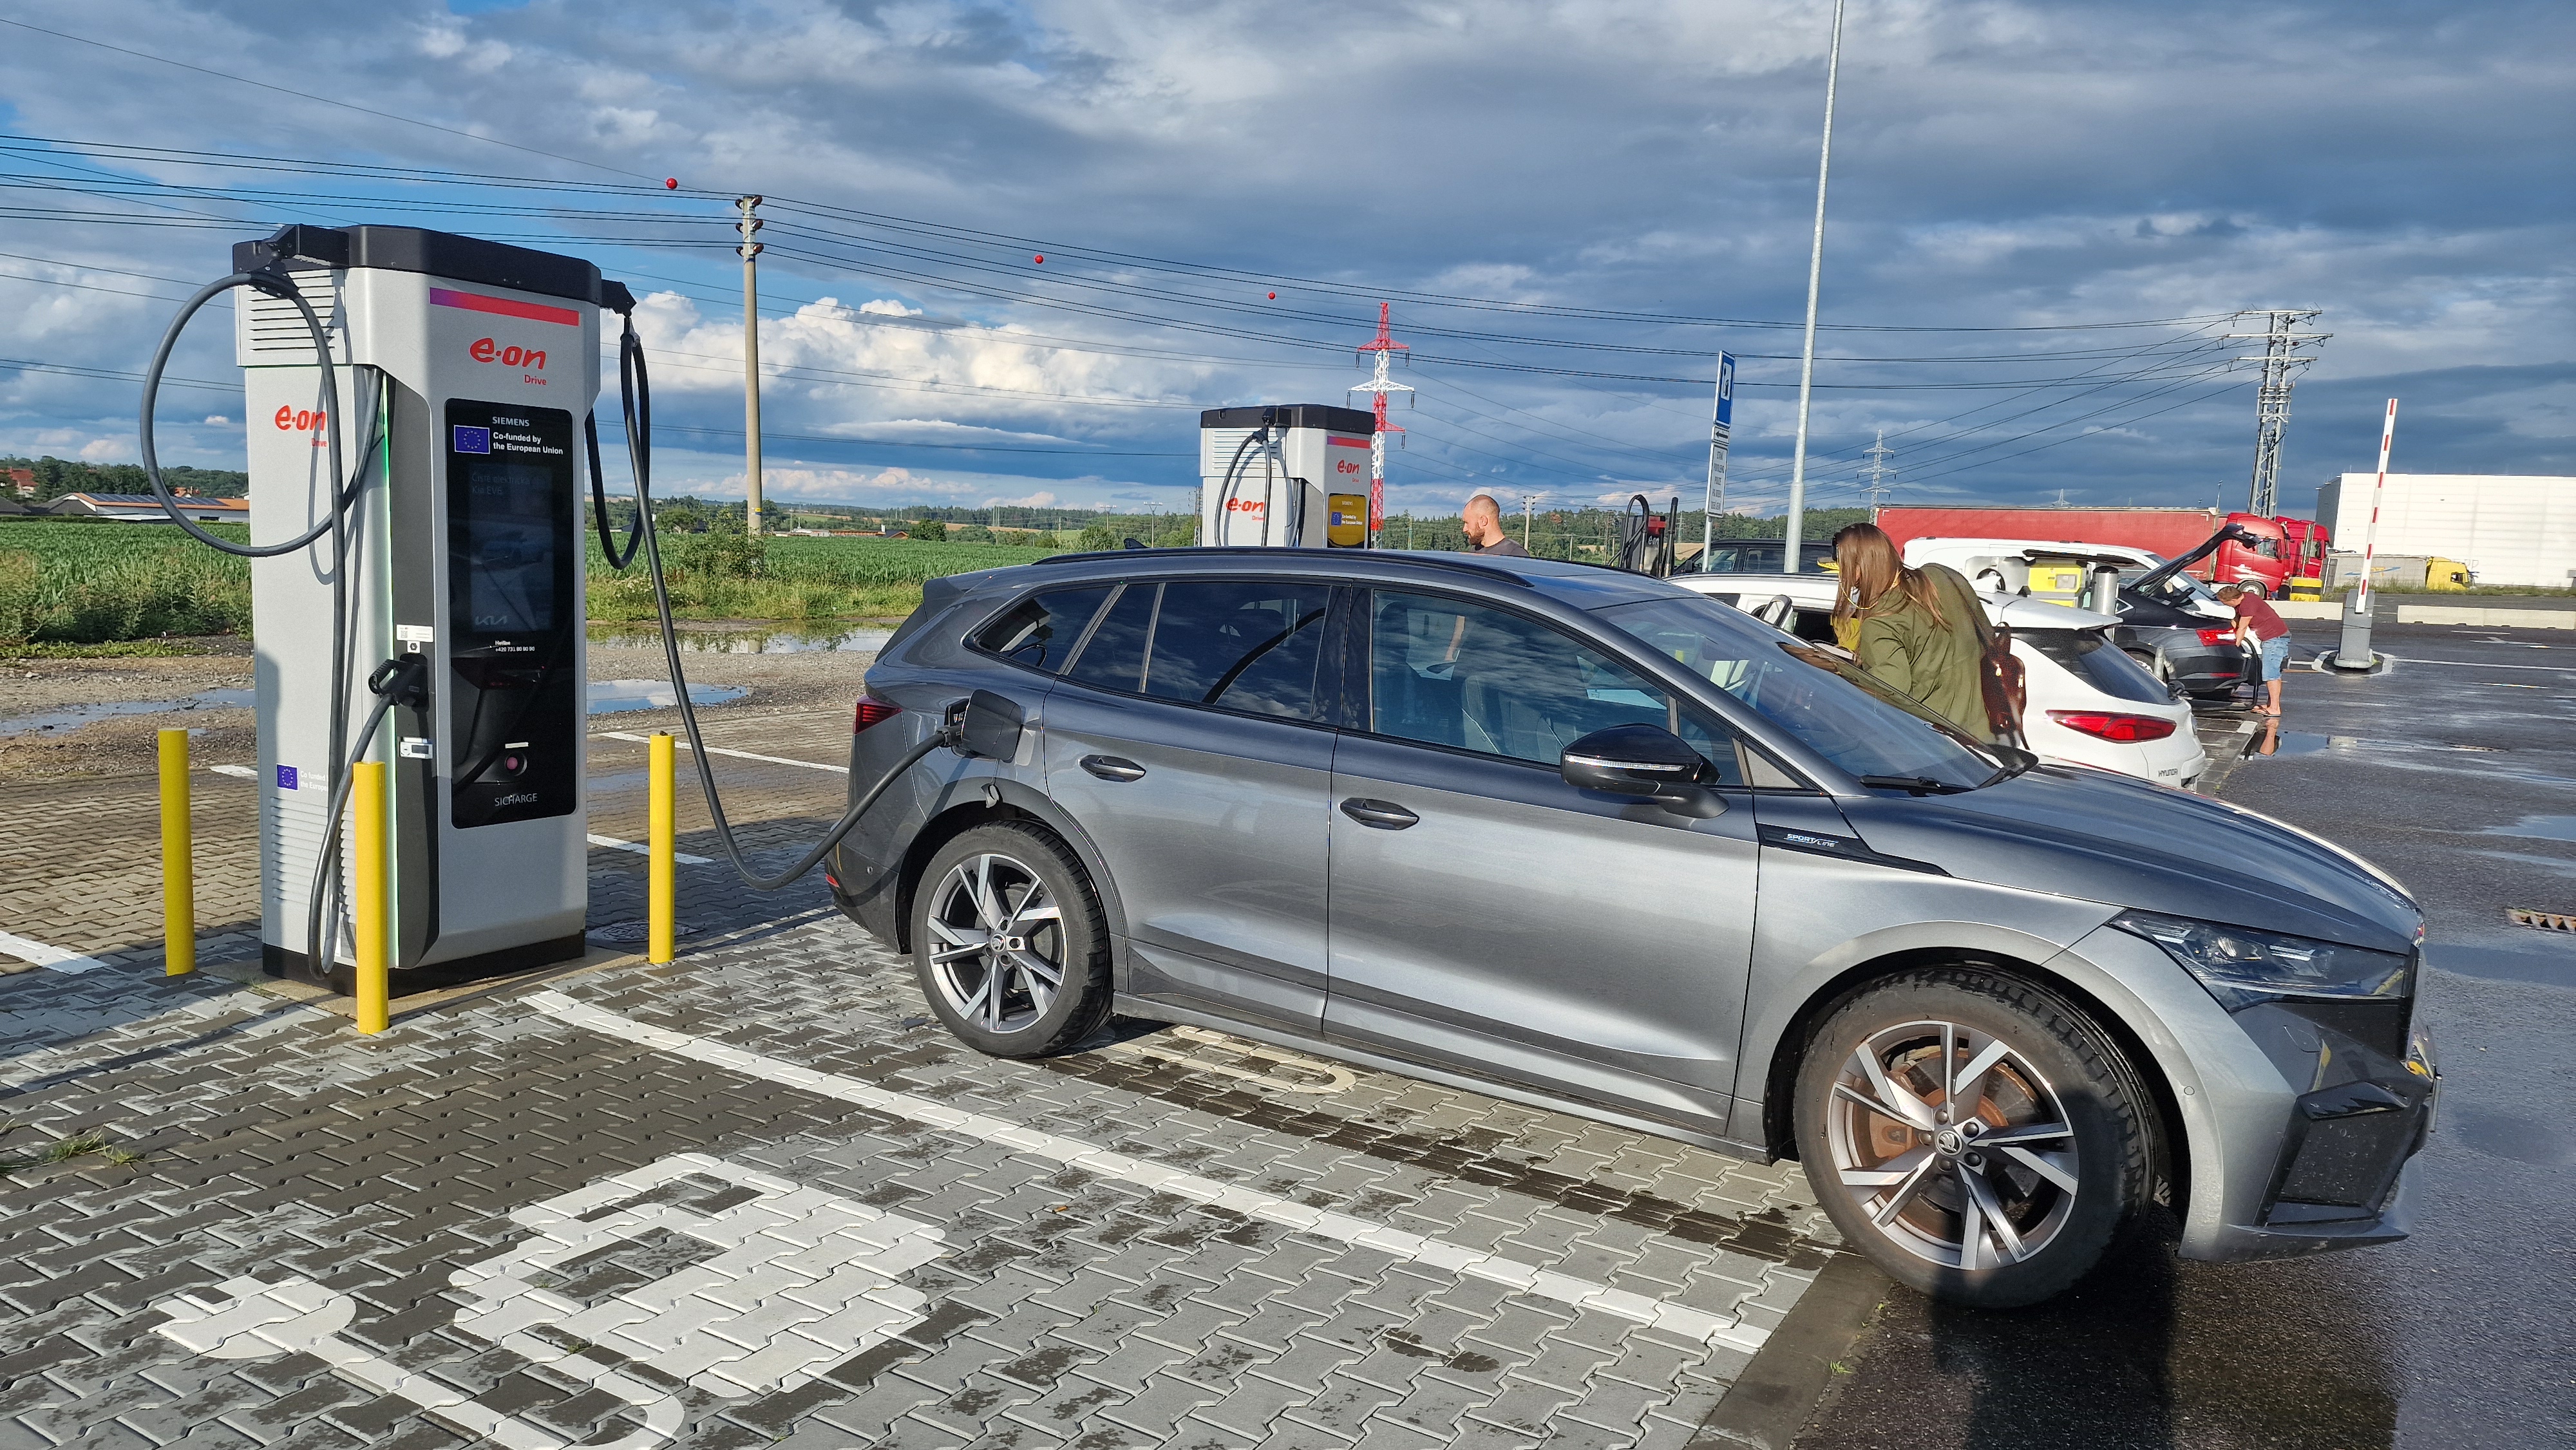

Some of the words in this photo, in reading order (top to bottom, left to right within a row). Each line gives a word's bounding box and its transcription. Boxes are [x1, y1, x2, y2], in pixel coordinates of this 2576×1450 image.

[524, 374, 547, 385] Drive
[492, 416, 530, 427] SIEMENS
[493, 431, 531, 442] Co-funded
[532, 435, 542, 444] by
[493, 442, 505, 450] the
[506, 443, 541, 453] European
[542, 446, 564, 455] Union
[309, 782, 328, 792] Europe
[495, 793, 538, 807] SICHARGE
